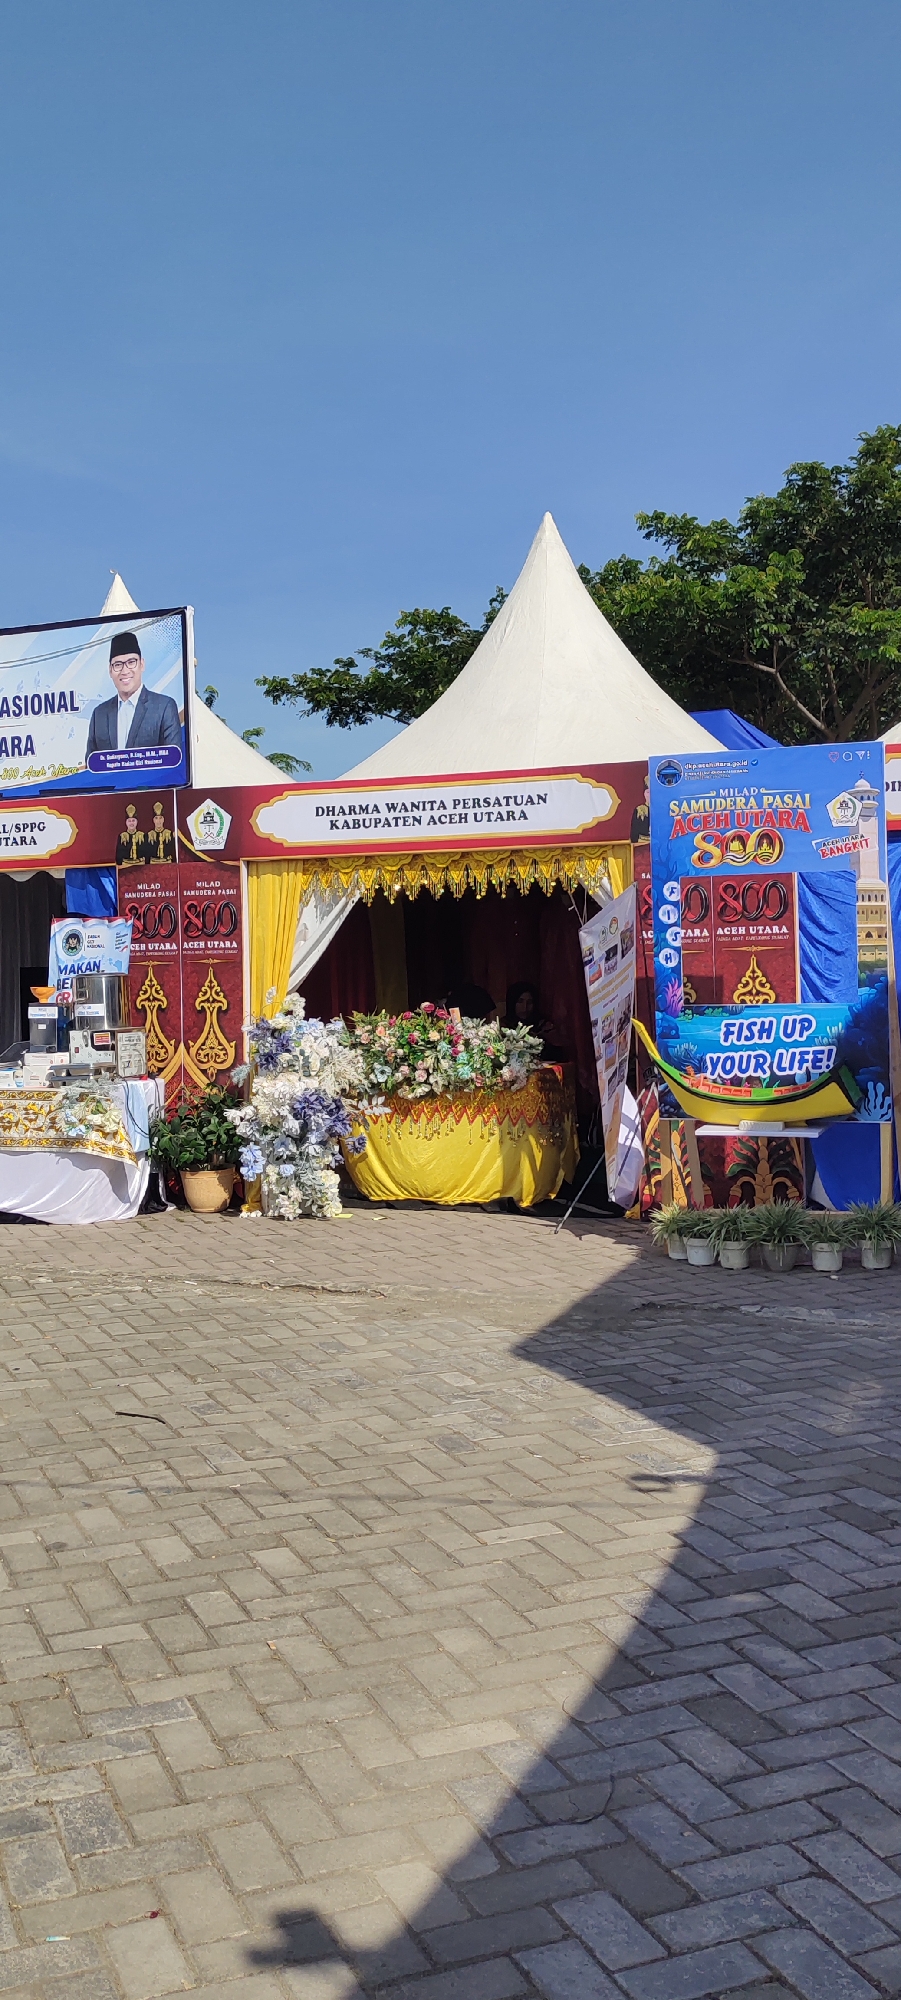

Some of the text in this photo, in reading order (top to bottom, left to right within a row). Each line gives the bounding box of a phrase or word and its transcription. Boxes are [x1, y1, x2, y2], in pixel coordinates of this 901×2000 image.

[20, 765, 47, 780] Aceh
[720, 787, 758, 797] MILAD
[315, 793, 548, 817] DHARMA WANITA PERSATUAN
[669, 793, 811, 817] SAMUDERA PASAI
[0, 822, 46, 836] L/SPPG
[329, 809, 529, 830] KABUPATEN ACEH UTARA
[669, 809, 812, 839] ACEH UTARA
[691, 827, 785, 869] 800
[820, 838, 870, 859] BANGKIT
[822, 833, 865, 848] ACEH UTARA
[717, 879, 788, 922] 800
[183, 900, 238, 938] 800
[716, 925, 789, 935] ACEH UTARA
[148, 942, 178, 950] UTARA
[207, 940, 238, 948] UTARA
[58, 960, 101, 975] MAKAN
[57, 978, 73, 991] BE
[723, 1017, 813, 1043] FISH UP
[709, 1050, 833, 1076] YOUR LIFE!
